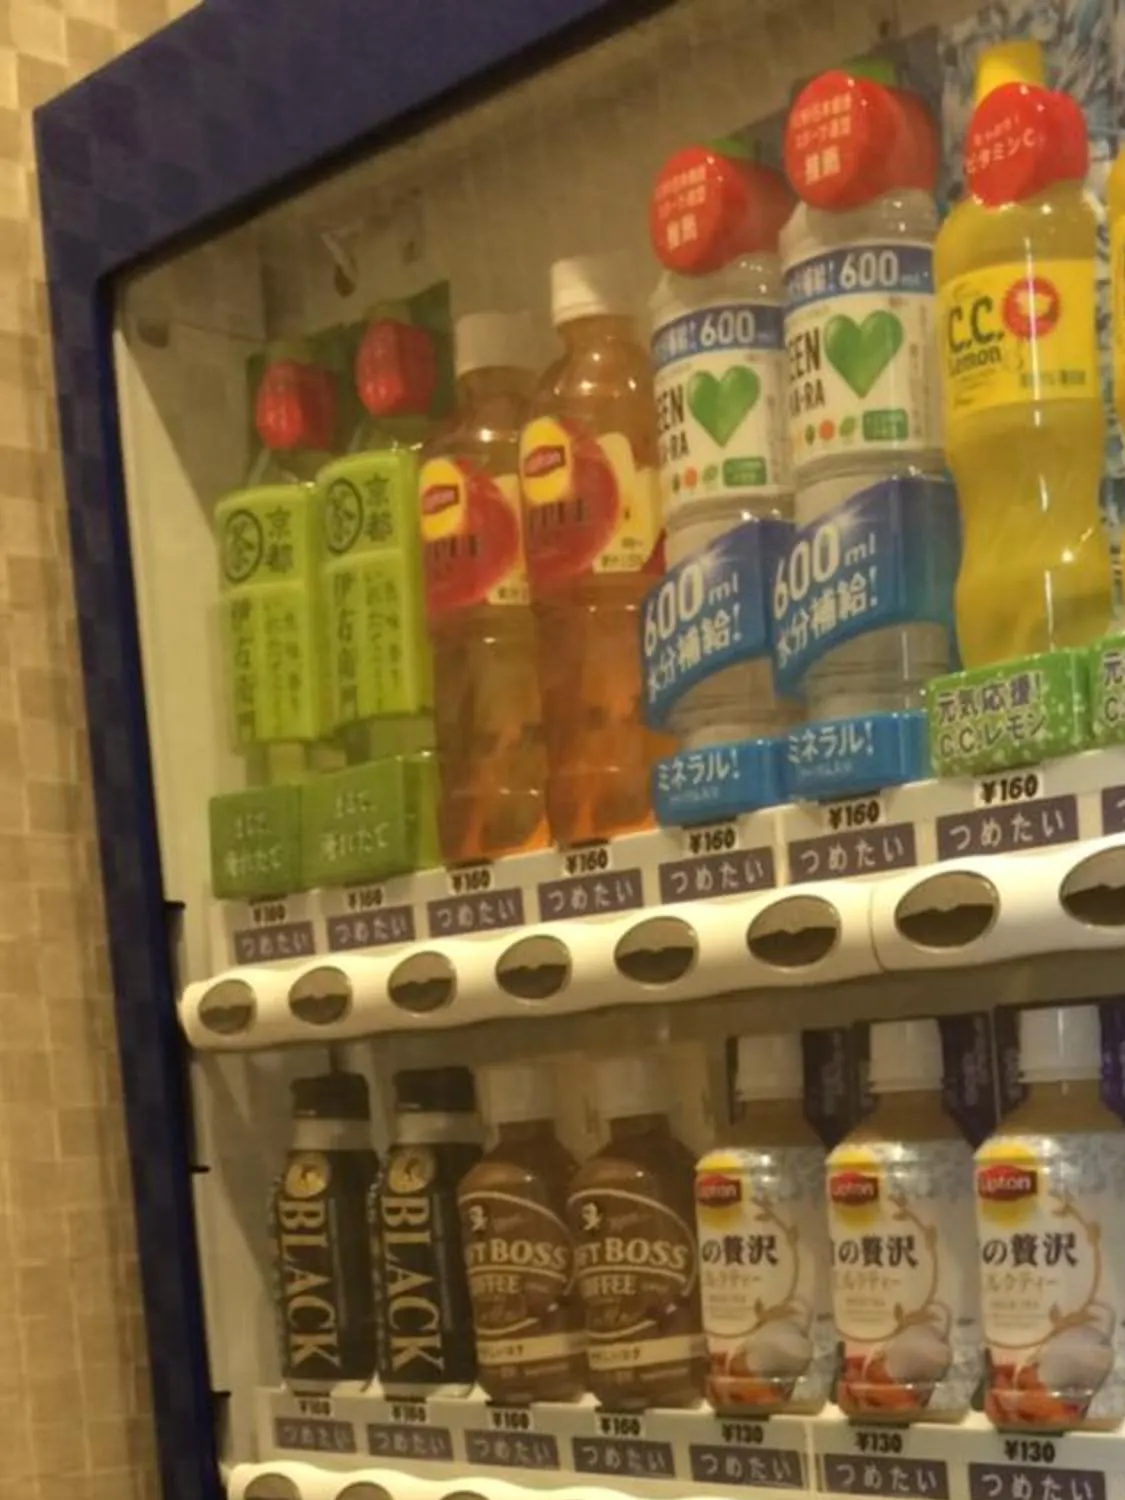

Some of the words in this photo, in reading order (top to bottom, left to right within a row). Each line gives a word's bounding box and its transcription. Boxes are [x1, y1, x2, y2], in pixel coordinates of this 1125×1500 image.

[947, 296, 1005, 354] C.C.
[937, 671, 1043, 726] 元気応援!
[788, 721, 875, 765] ミネラル!
[939, 711, 1048, 760] C.C.レモン
[656, 749, 741, 791] ミネラル!
[981, 774, 1039, 804] ¥160
[828, 801, 880, 828] ¥160
[949, 810, 1065, 850] つめたい
[688, 833, 736, 854] ¥160
[800, 834, 906, 874] つめたい
[670, 858, 765, 894] つめたい
[435, 895, 518, 928] つめたい
[545, 878, 636, 913] つめたい
[490, 1237, 568, 1271] BOSS
[604, 1236, 689, 1271] BOSS
[701, 1234, 779, 1267] の贅沢
[831, 1234, 919, 1268] の贅沢
[981, 1232, 1079, 1268] の贅沢
[278, 1201, 341, 1370] BLACK
[382, 1196, 445, 1371] BLACK
[473, 1437, 553, 1464] つめたい
[721, 1423, 763, 1446] ¥130
[855, 1430, 903, 1453] ¥130
[1004, 1439, 1056, 1463] ¥130
[580, 1444, 665, 1471] つめたい
[700, 1451, 792, 1482] つめたい
[835, 1461, 937, 1493] つめたい
